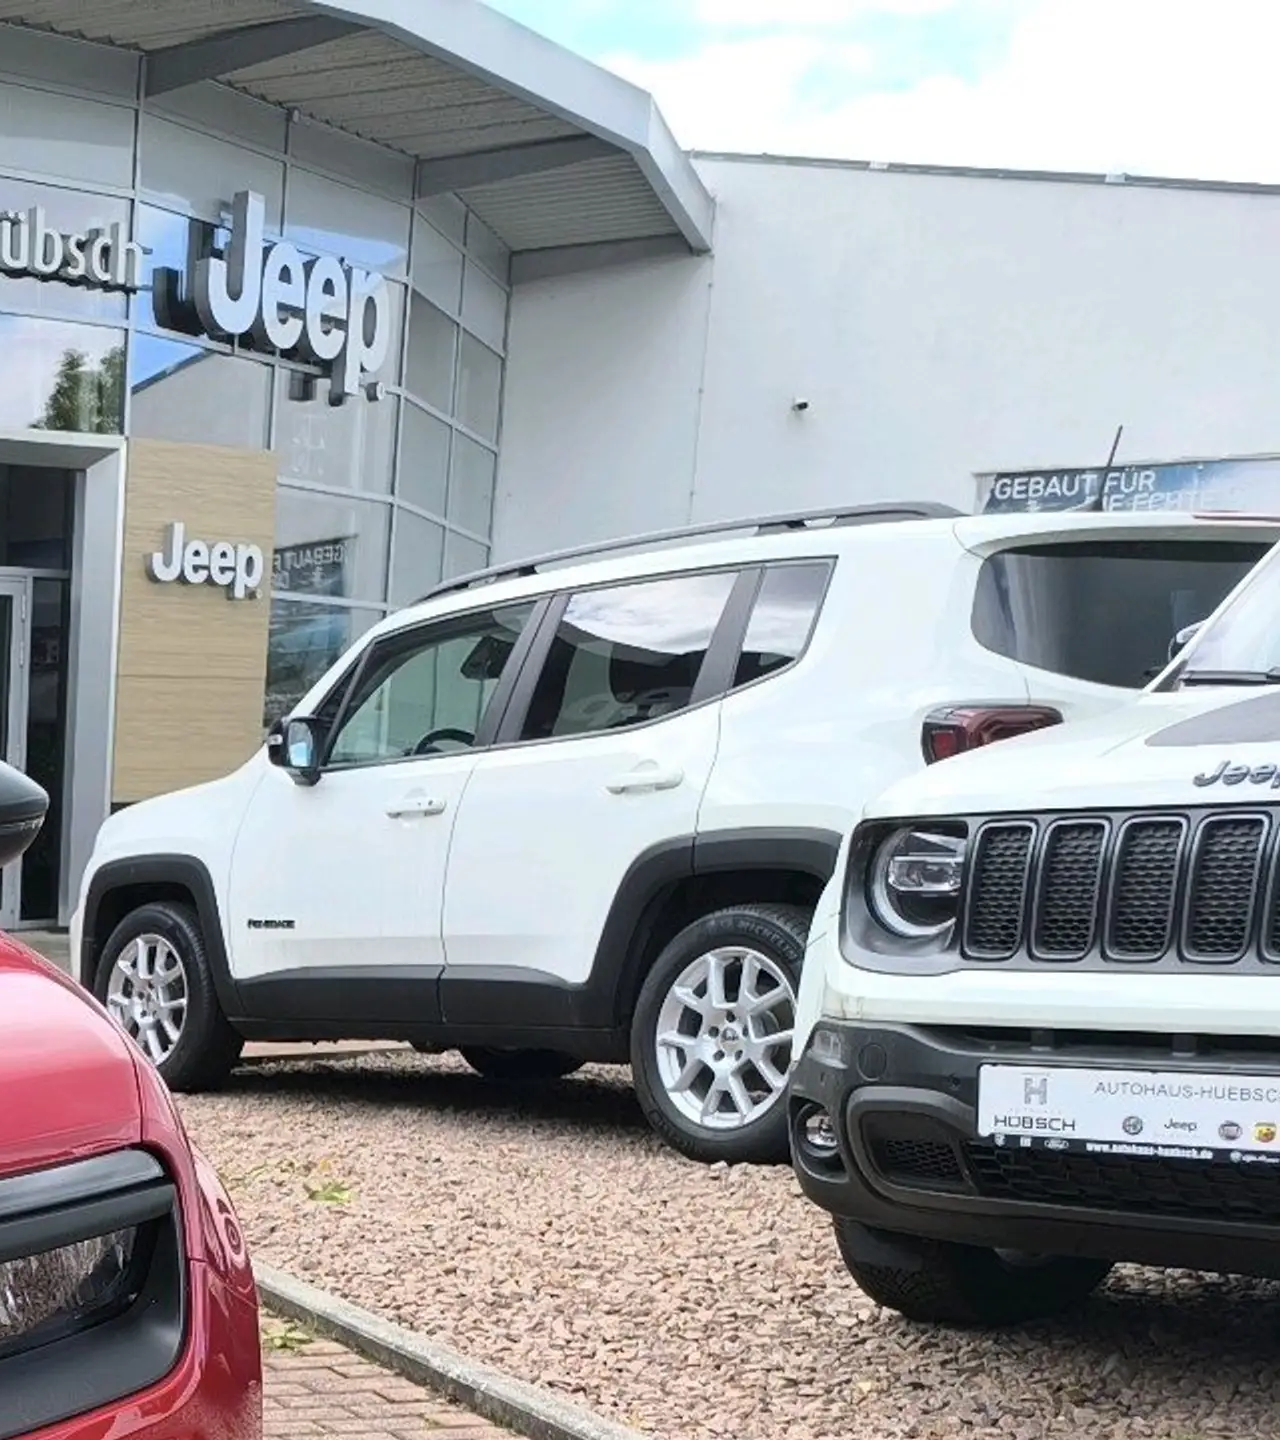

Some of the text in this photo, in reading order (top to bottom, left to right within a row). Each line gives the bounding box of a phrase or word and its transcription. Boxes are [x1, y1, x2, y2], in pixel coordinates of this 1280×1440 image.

[198, 190, 390, 396] Jeep
[994, 465, 1156, 500] GEBAUT FÜR
[150, 521, 264, 599] Jeep
[1094, 1081, 1280, 1103] AUTOHAUS-HUEBSC
[1163, 1117, 1198, 1132] Jeep
